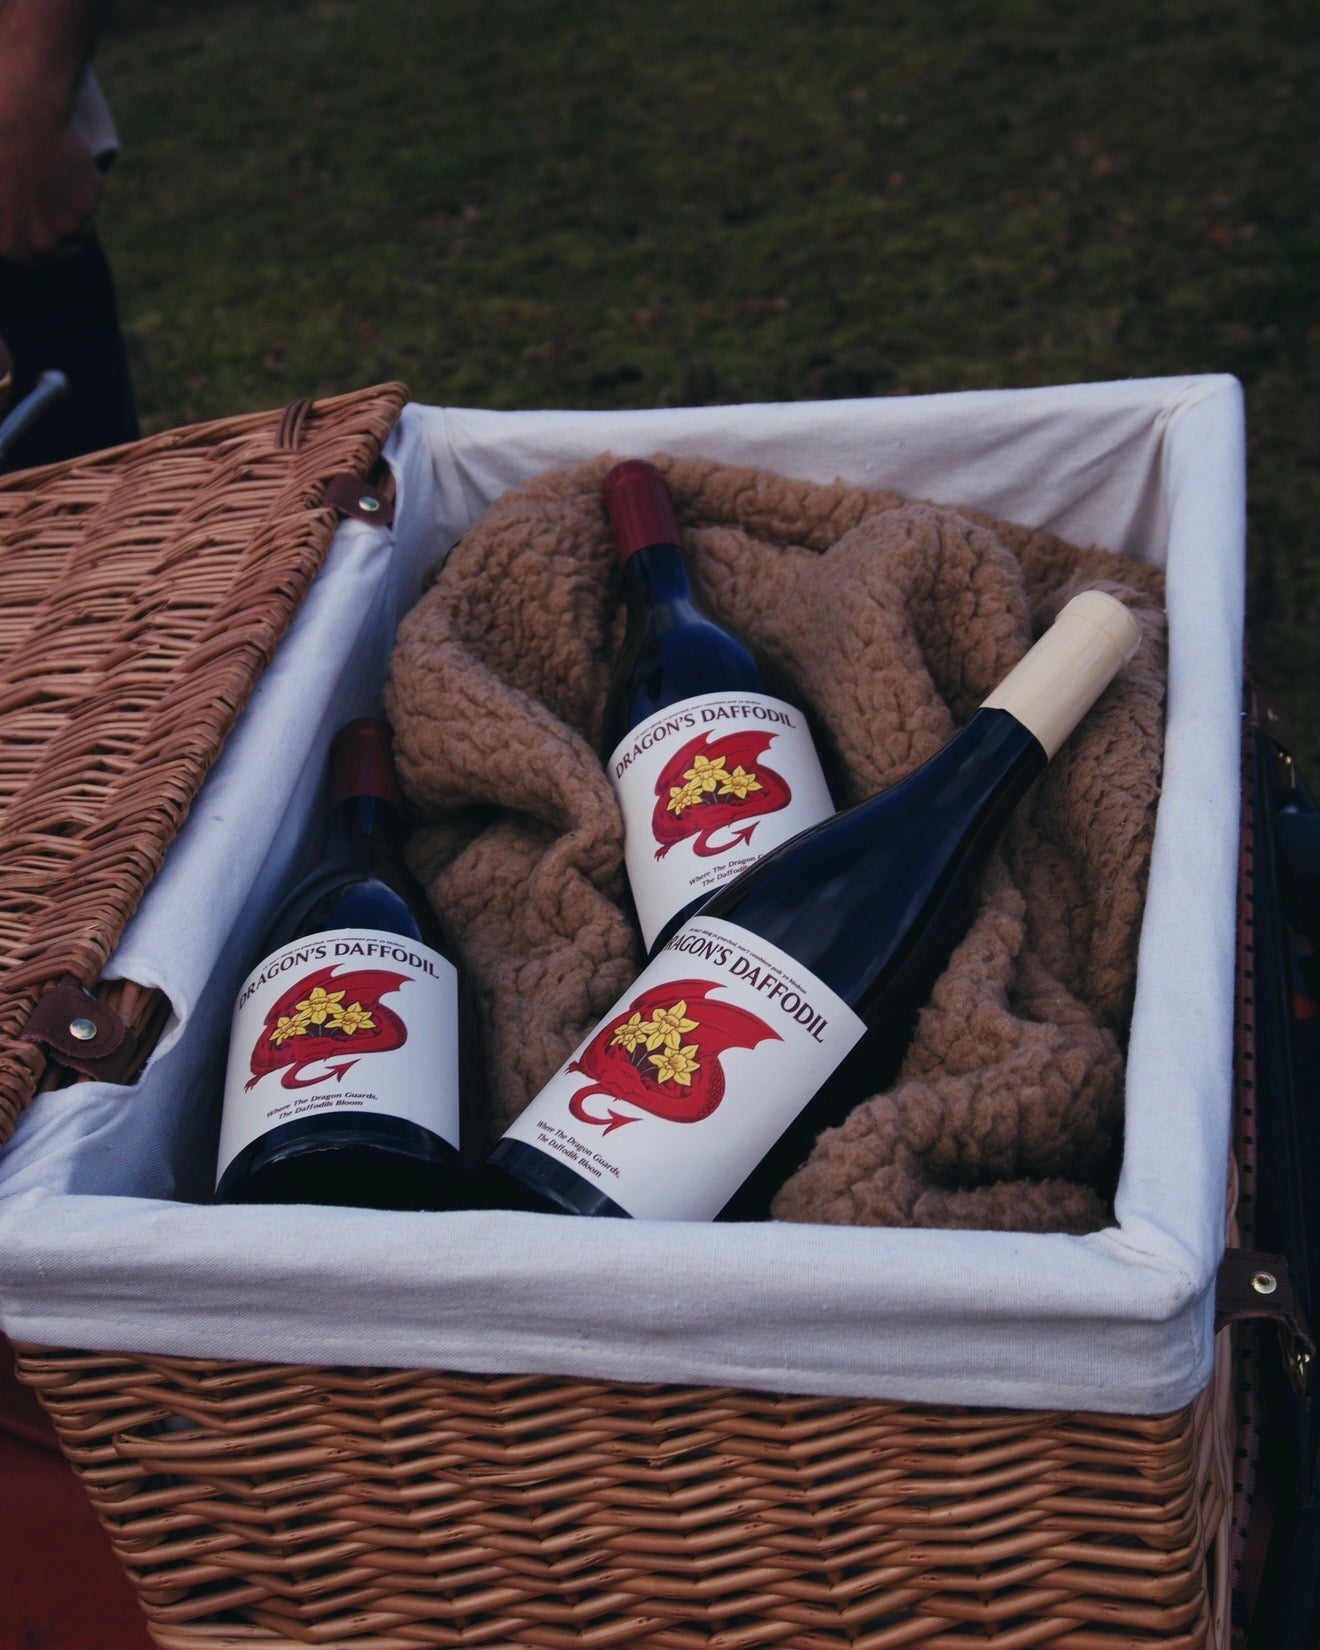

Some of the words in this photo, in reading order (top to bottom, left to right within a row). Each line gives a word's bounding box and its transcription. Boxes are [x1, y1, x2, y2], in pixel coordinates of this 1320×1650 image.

[615, 713, 695, 779] DRAGON'S
[701, 705, 796, 729] DAFFODIL
[689, 871, 711, 886] Where
[713, 864, 726, 874] The
[728, 856, 756, 867] Dragon
[702, 877, 715, 887] The
[717, 865, 750, 880] Daffodil
[239, 945, 327, 1011] DRAGON'S
[334, 942, 440, 980] DAFFODIL
[663, 934, 733, 966] RAGON'S
[729, 956, 828, 1044] DAFFODIL
[266, 1104, 291, 1118] Where
[294, 1098, 309, 1106] The
[311, 1093, 342, 1102] Dragon
[344, 1091, 378, 1101] Guards,
[279, 1110, 293, 1119] The
[295, 1101, 333, 1114] Daffodils
[536, 1120, 555, 1133] Where
[555, 1129, 568, 1140] The
[567, 1136, 593, 1156] Dragon
[593, 1153, 620, 1178] Guards,
[537, 1133, 549, 1143] The
[548, 1139, 579, 1161] Daffodils
[578, 1158, 602, 1178] Bloom
